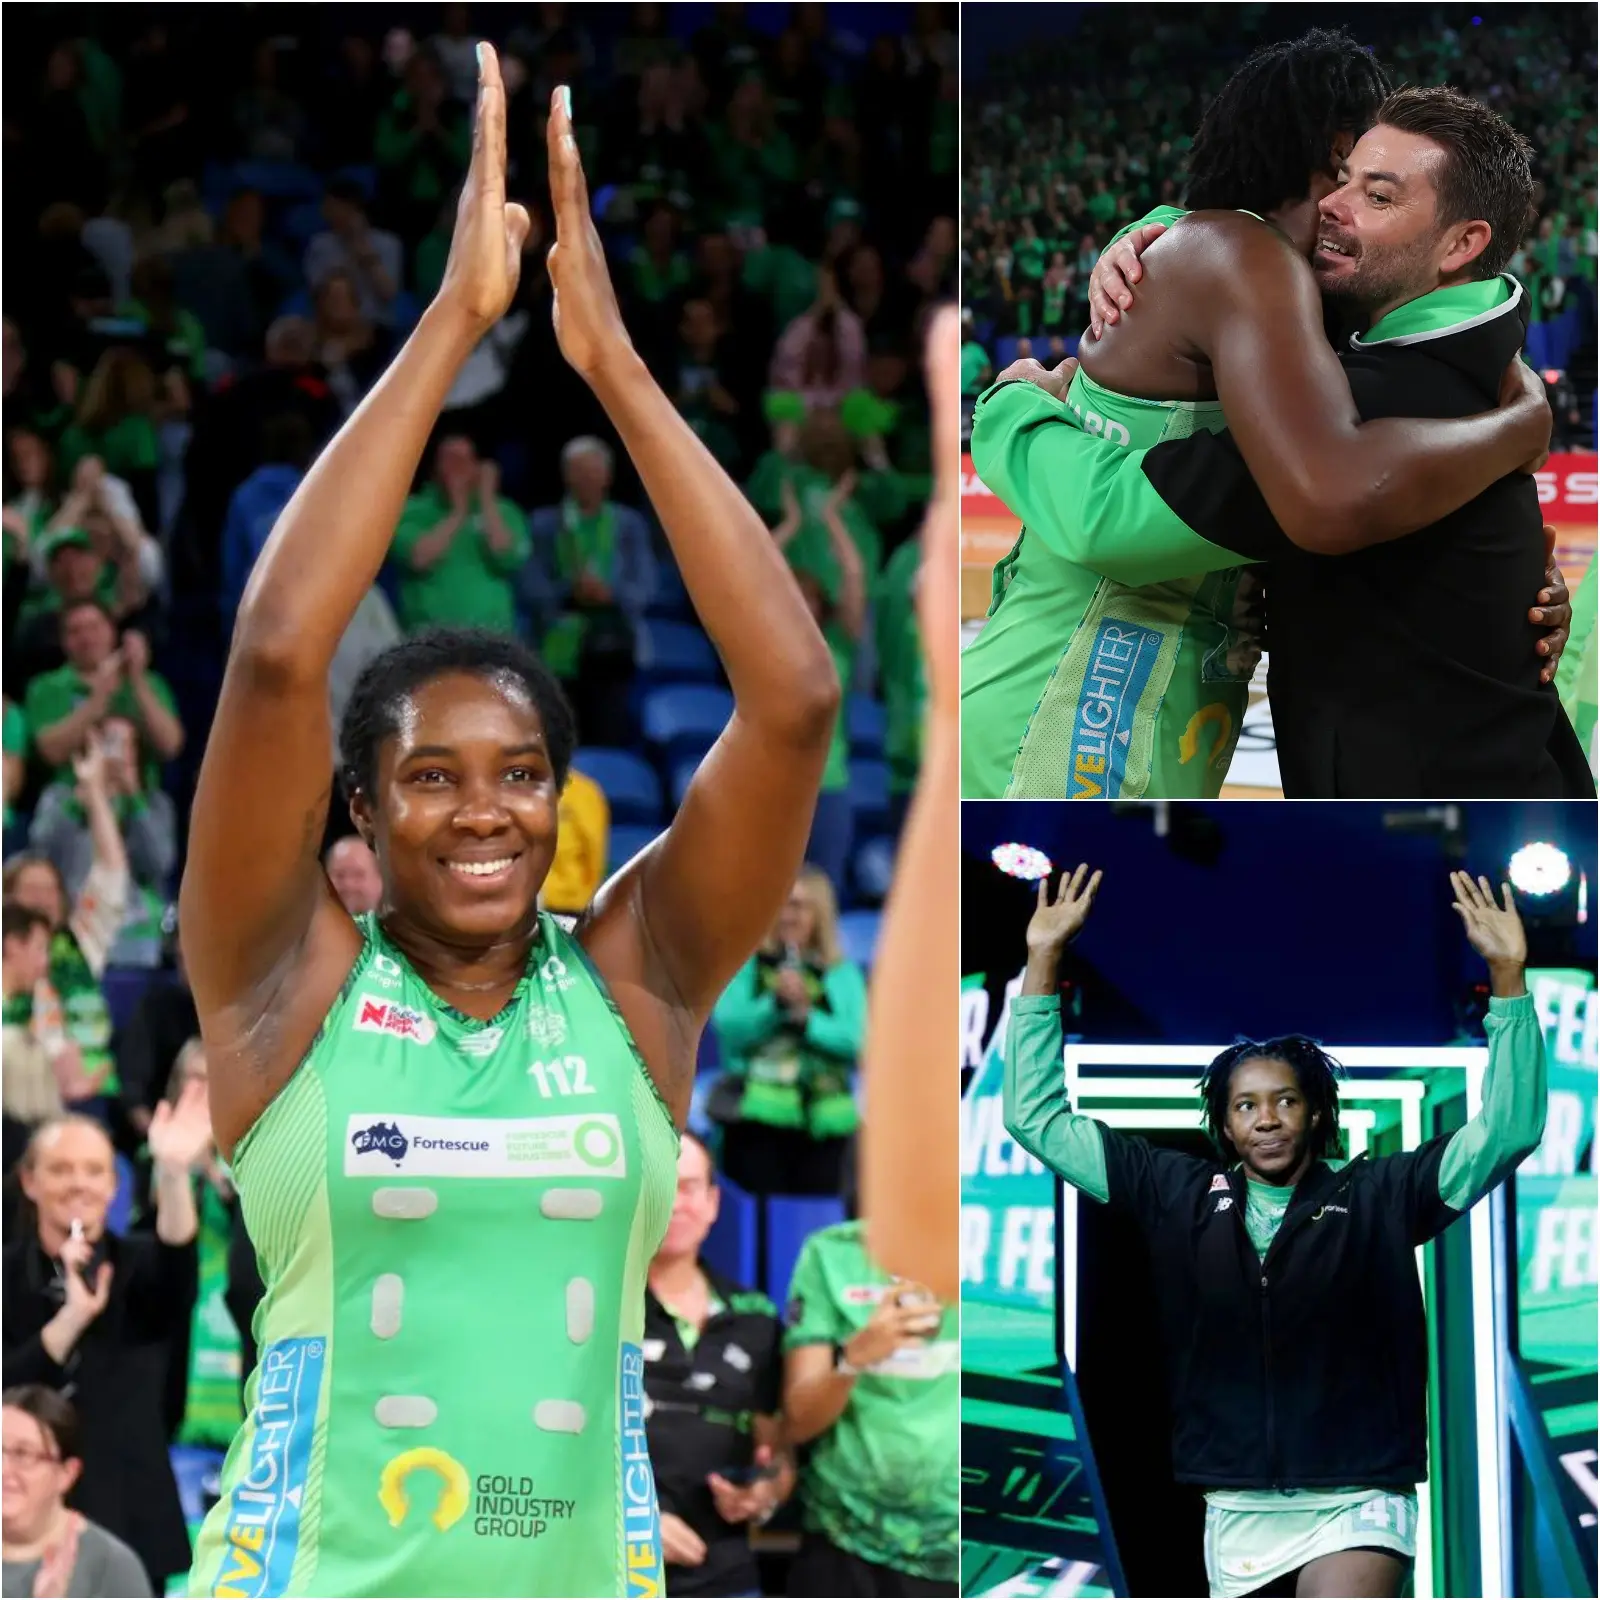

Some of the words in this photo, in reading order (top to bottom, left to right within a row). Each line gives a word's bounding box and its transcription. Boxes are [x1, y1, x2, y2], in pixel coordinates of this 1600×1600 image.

[527, 1055, 596, 1099] 112
[413, 1136, 490, 1151] Fortescue
[476, 1474, 533, 1496] GOLD
[475, 1495, 576, 1519] INDUSTRY
[474, 1517, 547, 1539] GROUP
